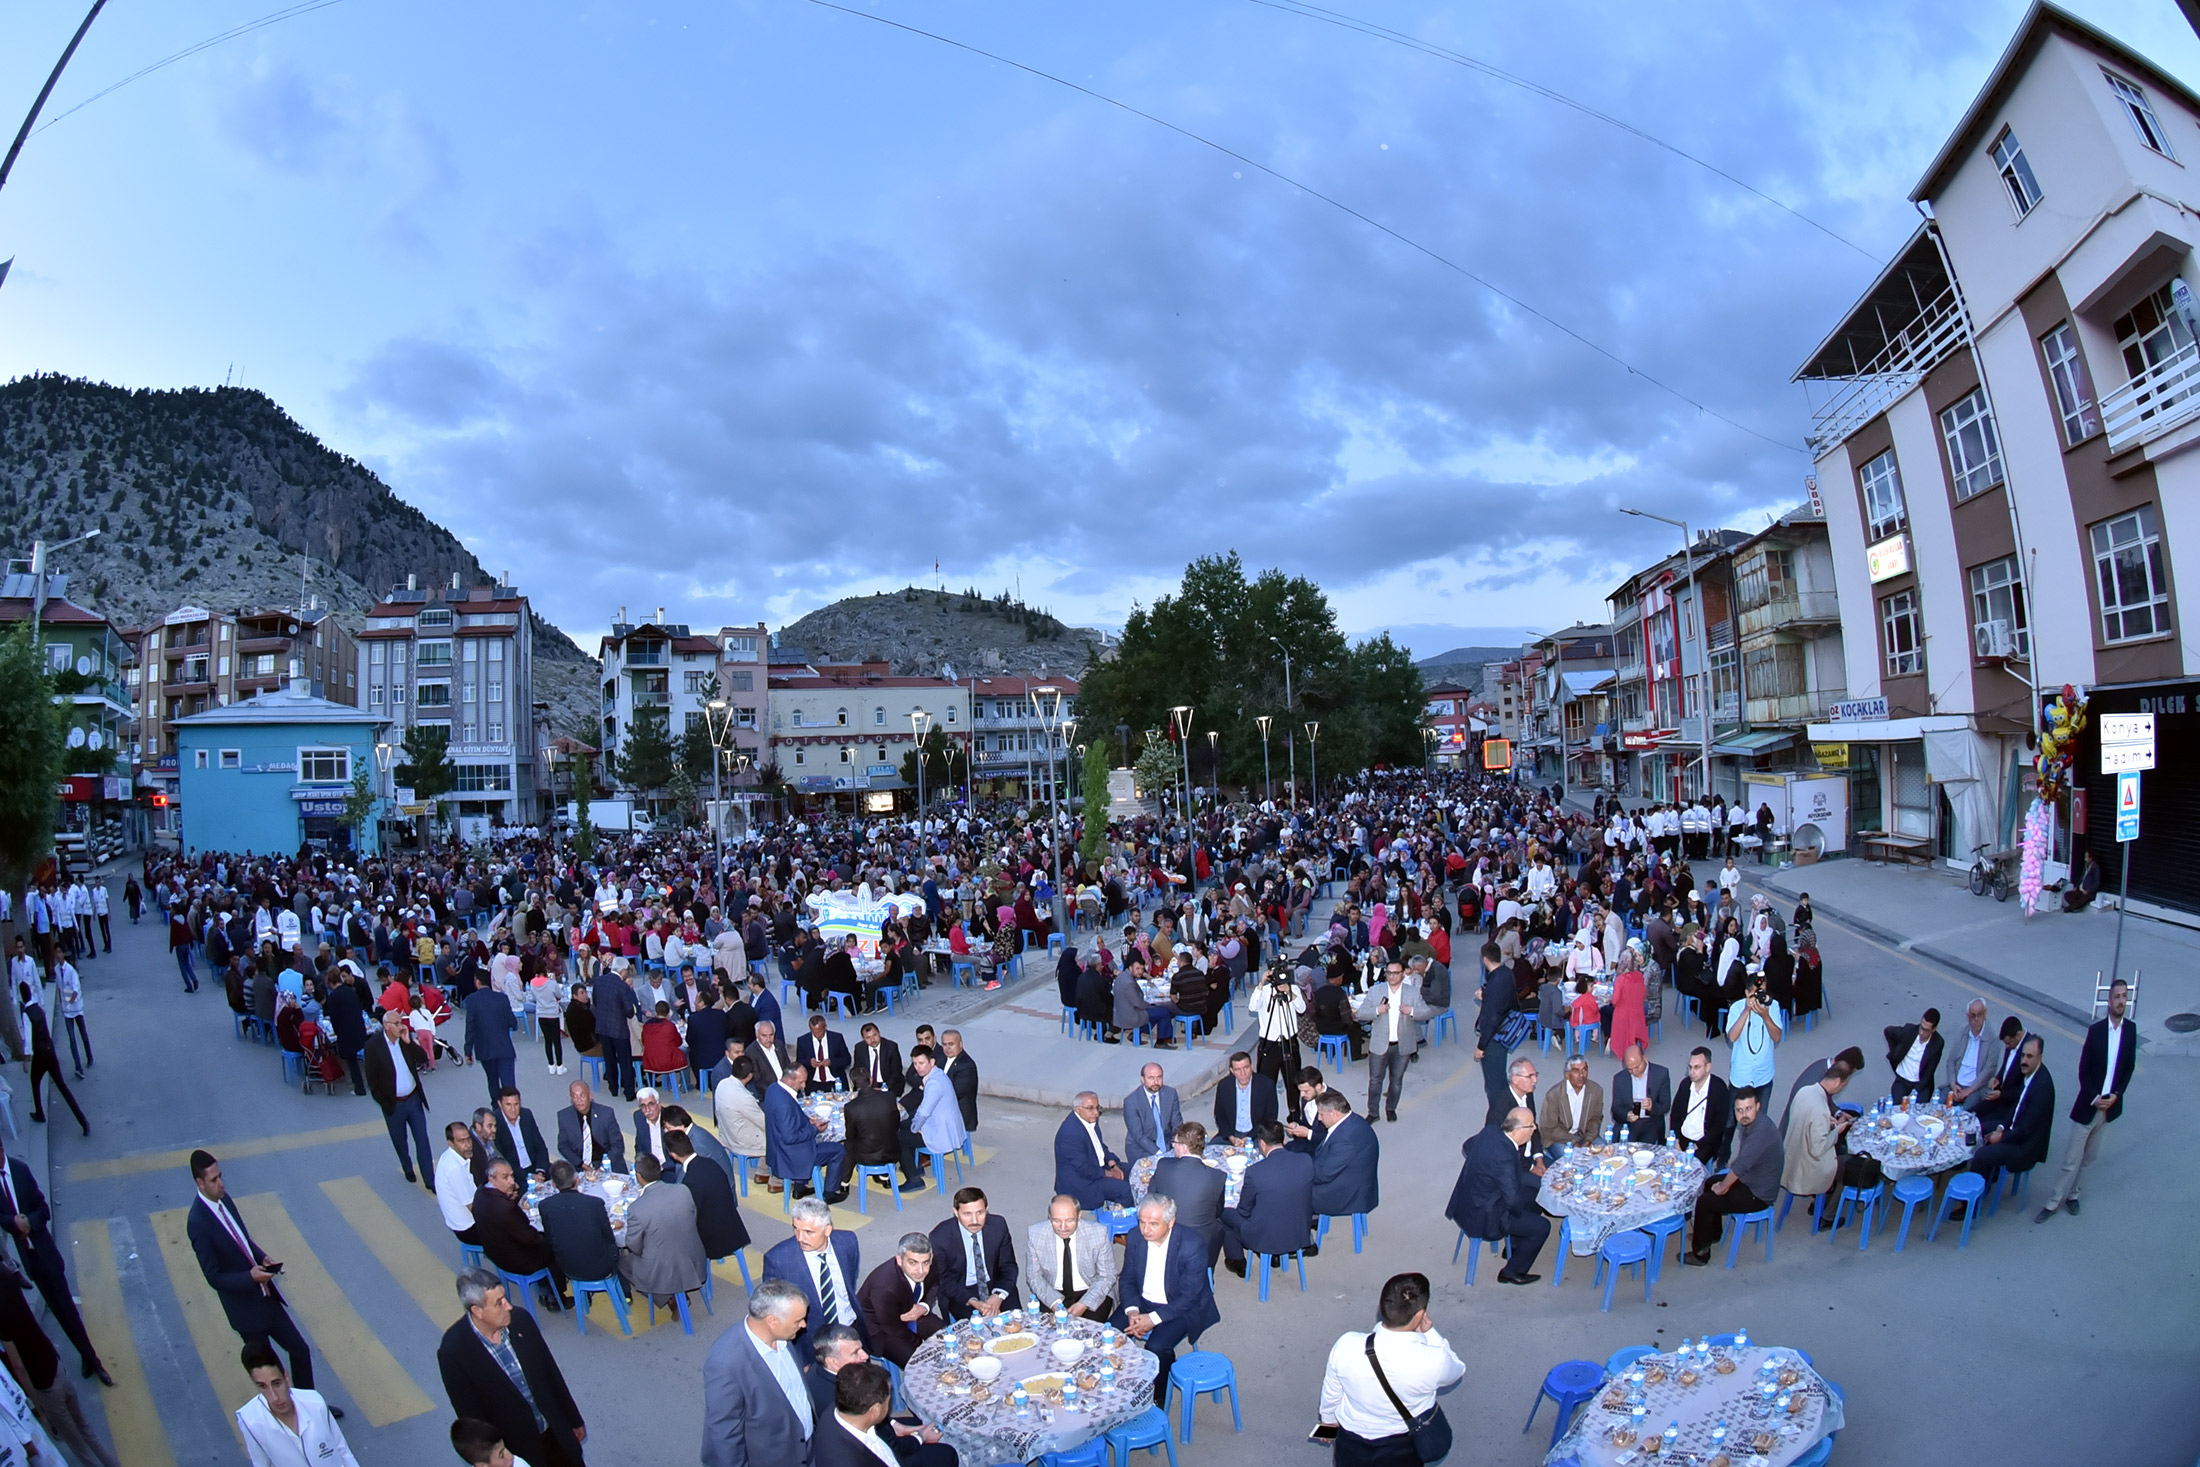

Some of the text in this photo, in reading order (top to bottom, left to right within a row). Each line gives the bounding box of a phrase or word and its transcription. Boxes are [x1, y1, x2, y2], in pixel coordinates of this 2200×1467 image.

[1841, 700, 1886, 721] KOÇAKLAR
[2103, 720, 2139, 737] Konya
[785, 732, 953, 746] OTEL BOZR
